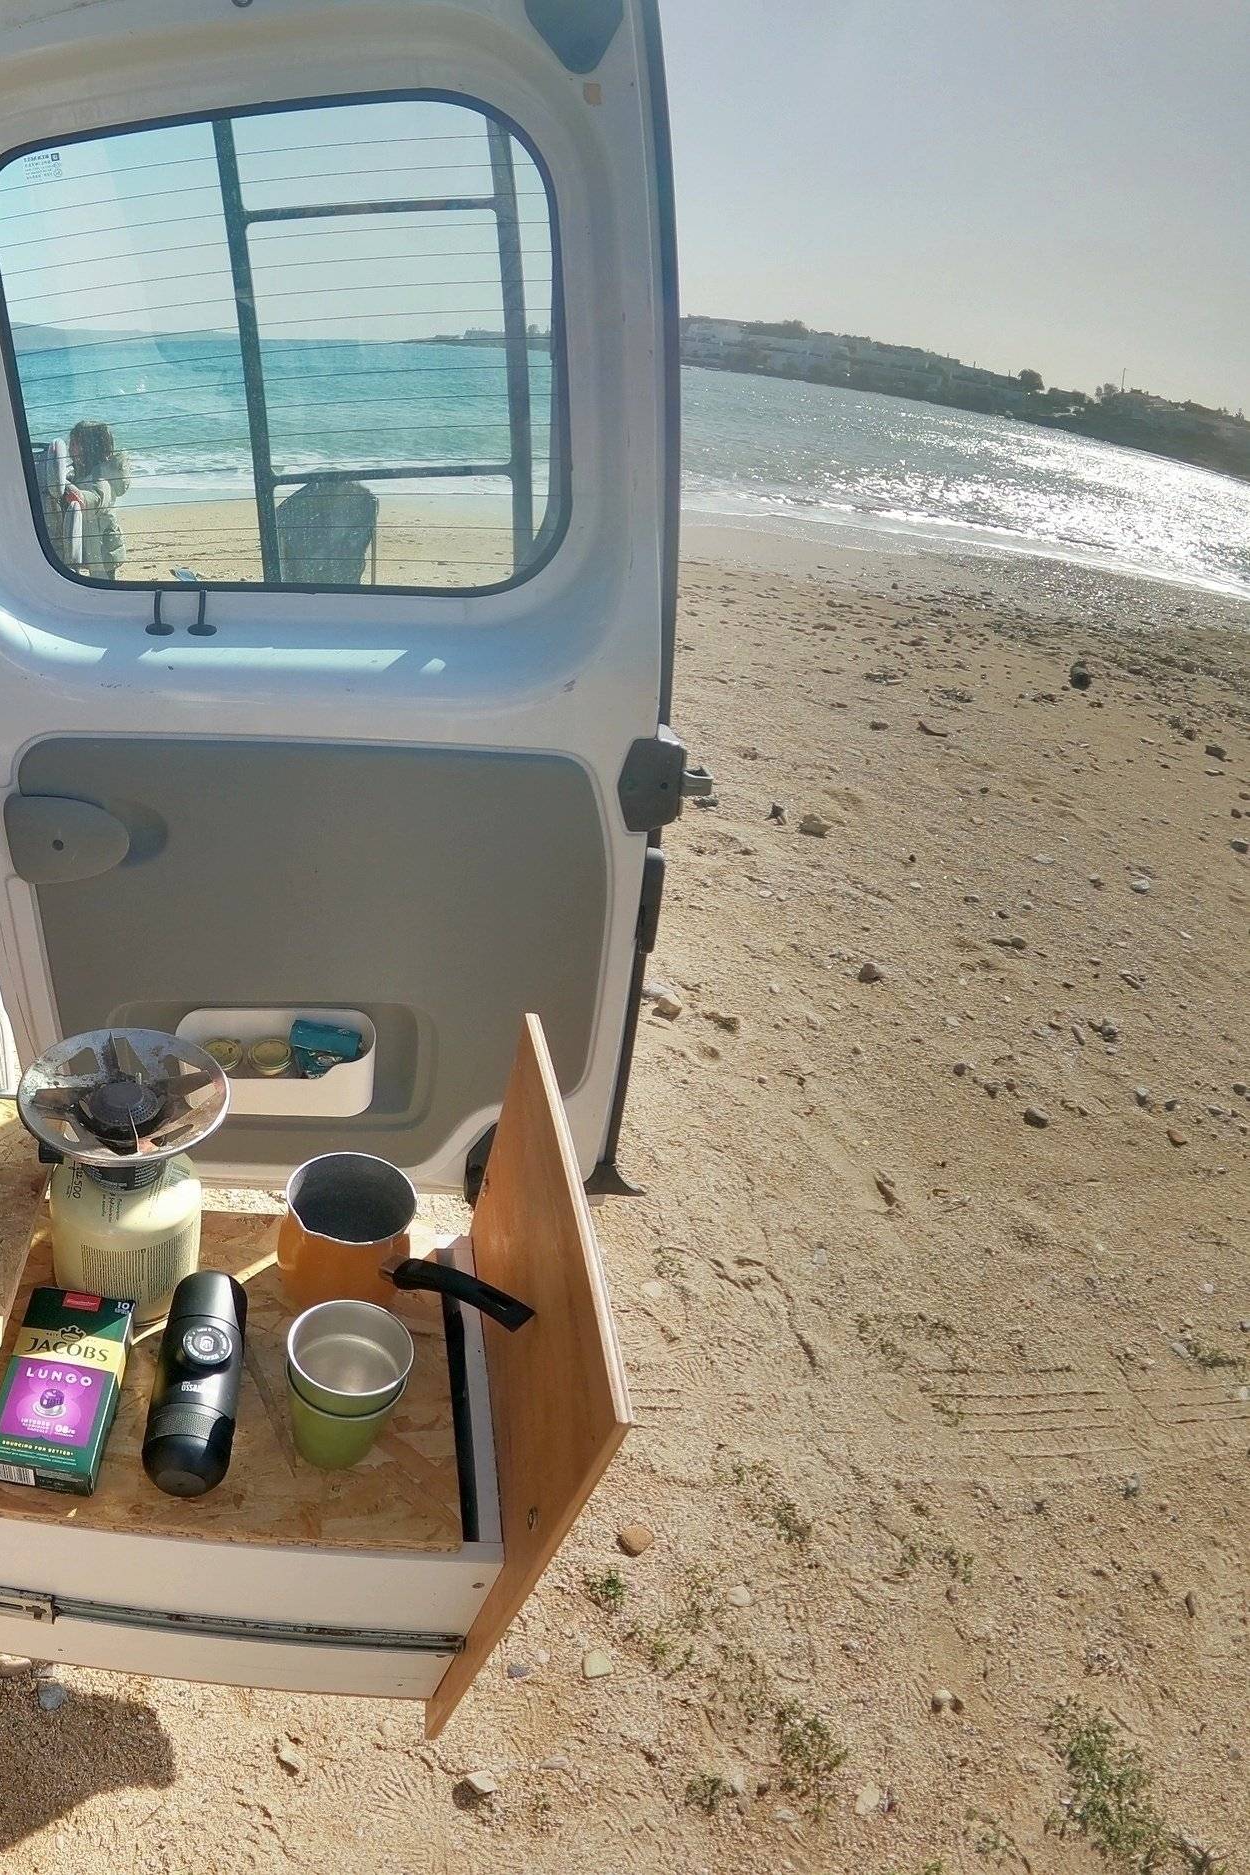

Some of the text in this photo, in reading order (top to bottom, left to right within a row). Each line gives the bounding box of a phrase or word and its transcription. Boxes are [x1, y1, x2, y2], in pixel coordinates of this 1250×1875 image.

[116, 1301, 130, 1310] 10
[24, 1337, 110, 1362] JACOBS
[26, 1366, 93, 1387] LUNGO
